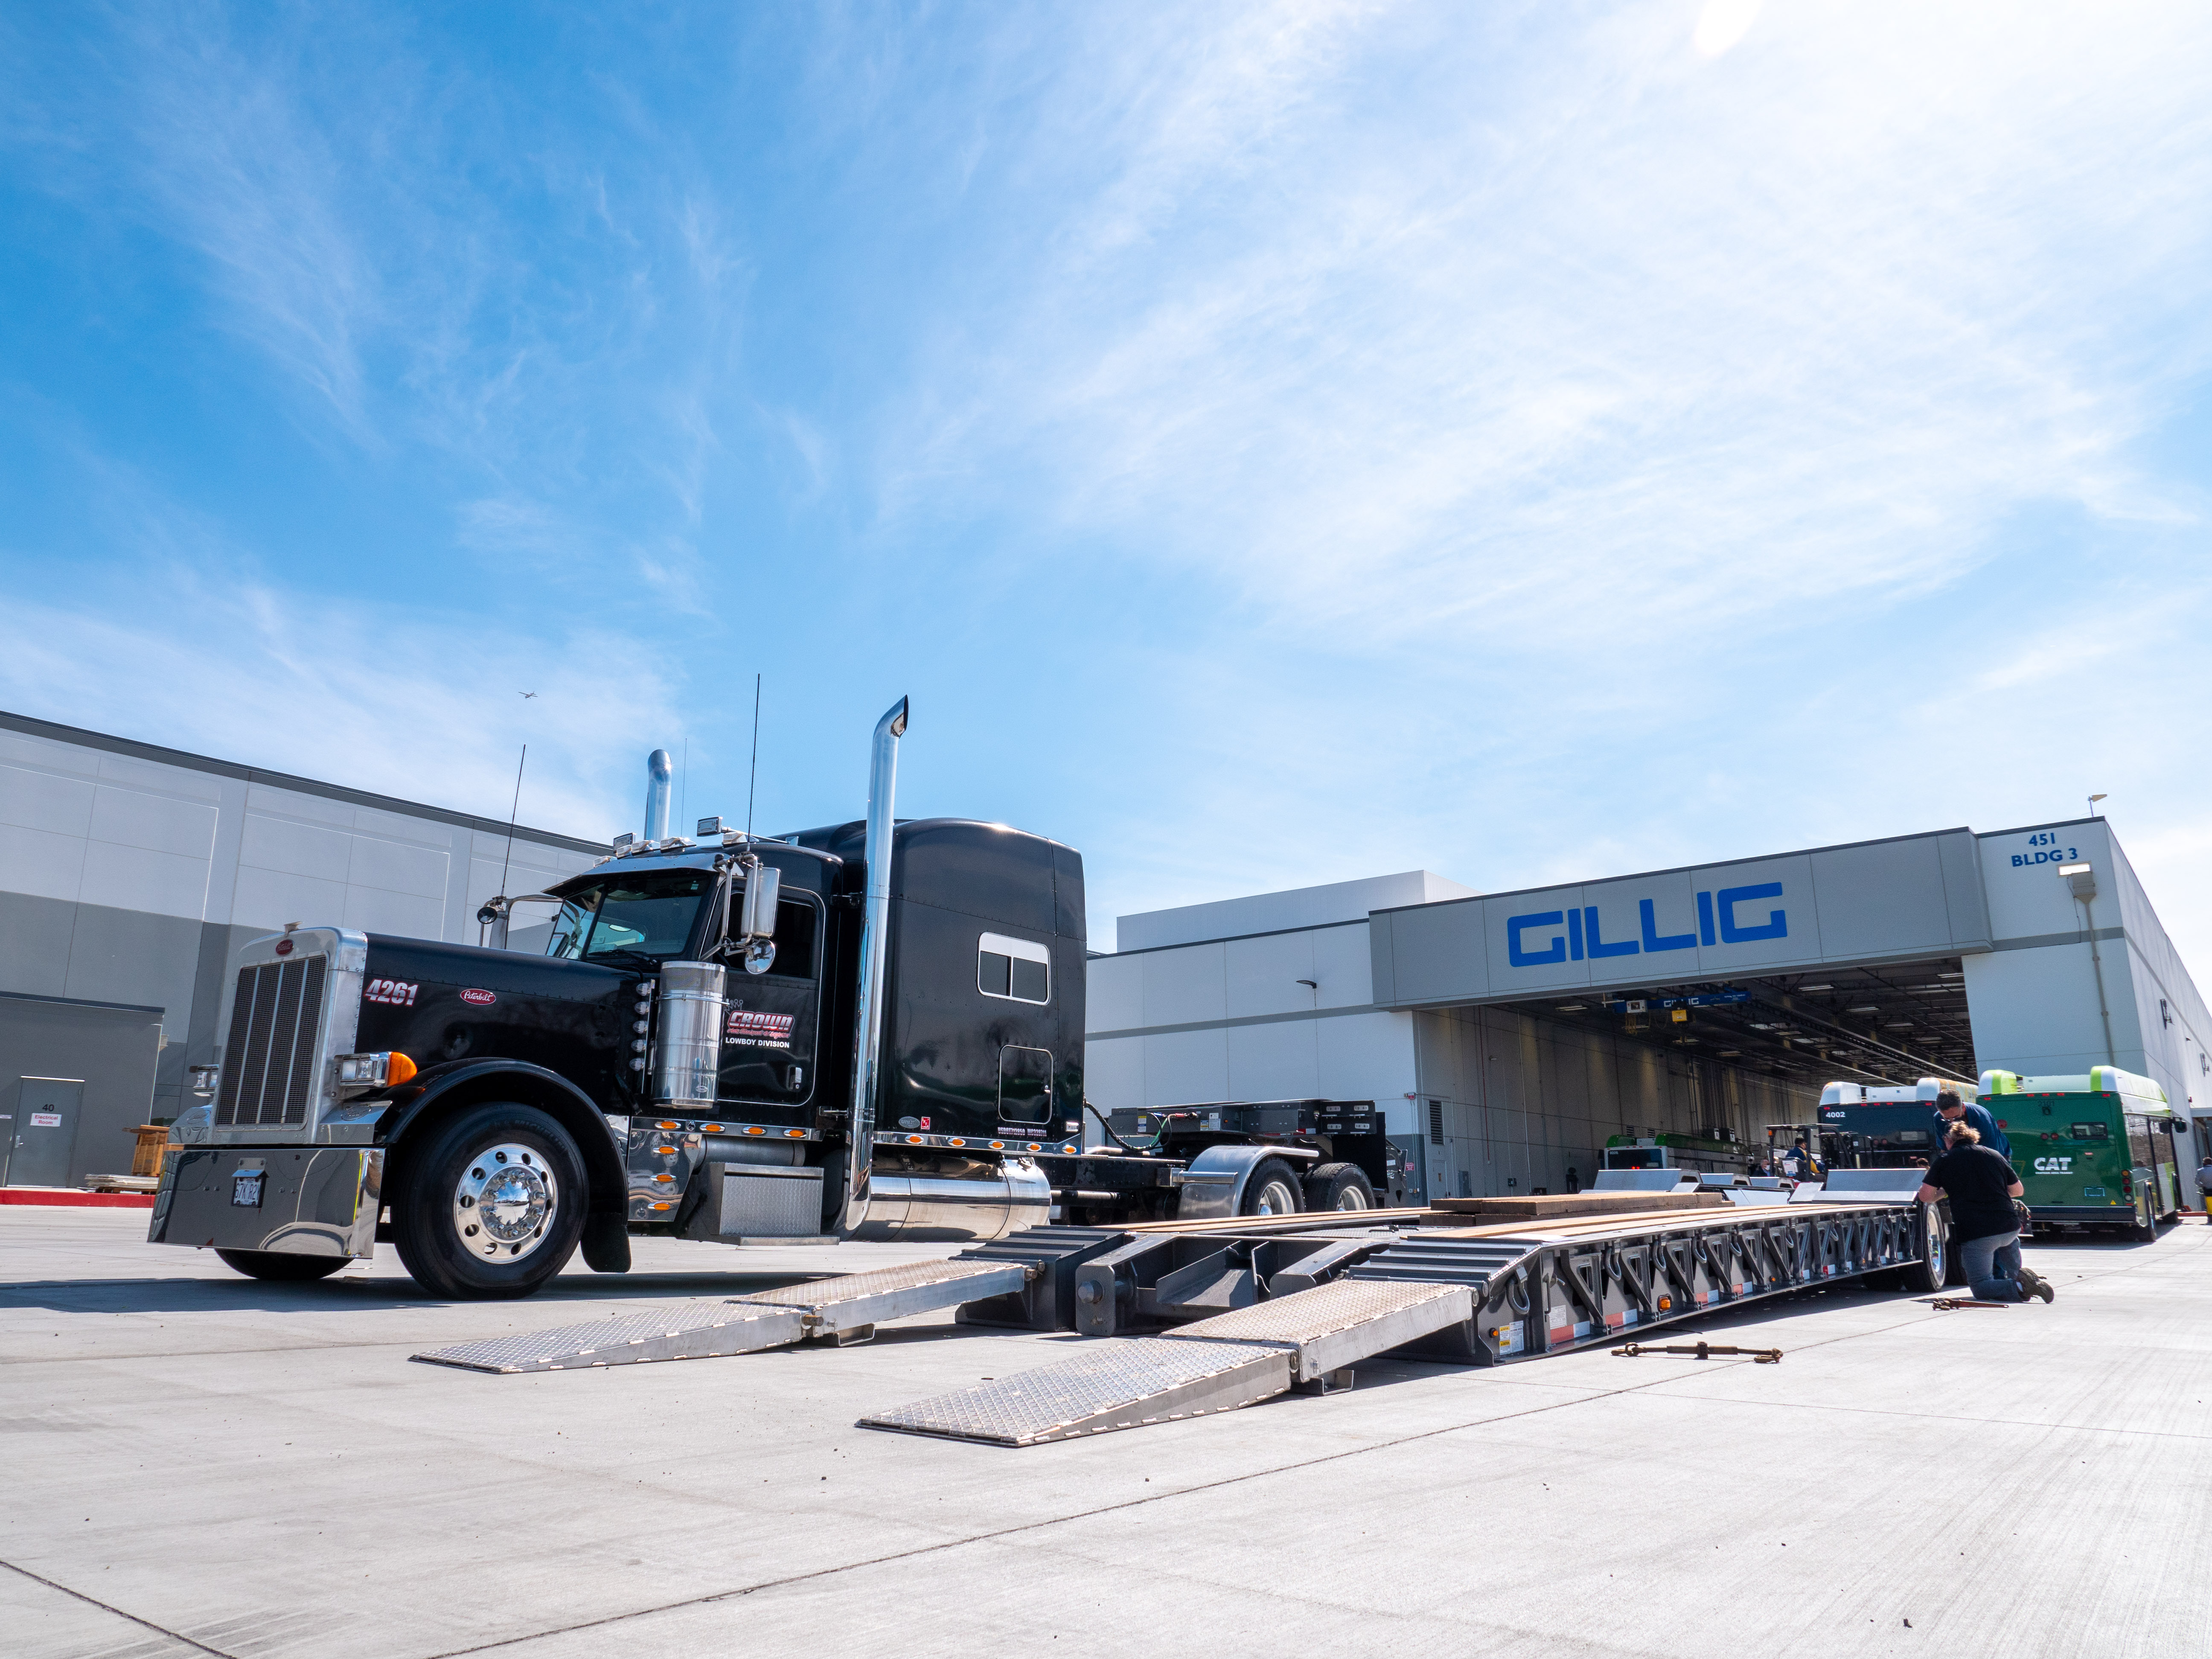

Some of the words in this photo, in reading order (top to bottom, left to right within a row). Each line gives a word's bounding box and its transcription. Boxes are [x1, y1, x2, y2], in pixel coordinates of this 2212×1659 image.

[2029, 832, 2055, 846] 451
[2011, 850, 2063, 867] BLDG
[2068, 847, 2078, 860] 3
[1507, 882, 1787, 967] GILLIG
[364, 978, 419, 1007] 4261
[464, 990, 493, 1002] Peterbilt
[1664, 997, 1700, 1007] GIIG
[729, 1012, 793, 1030] CROWN
[725, 1037, 757, 1045] LOWBOY
[758, 1040, 790, 1048] DIVISION
[42, 1104, 55, 1112] 40
[2034, 1157, 2072, 1171] CAT
